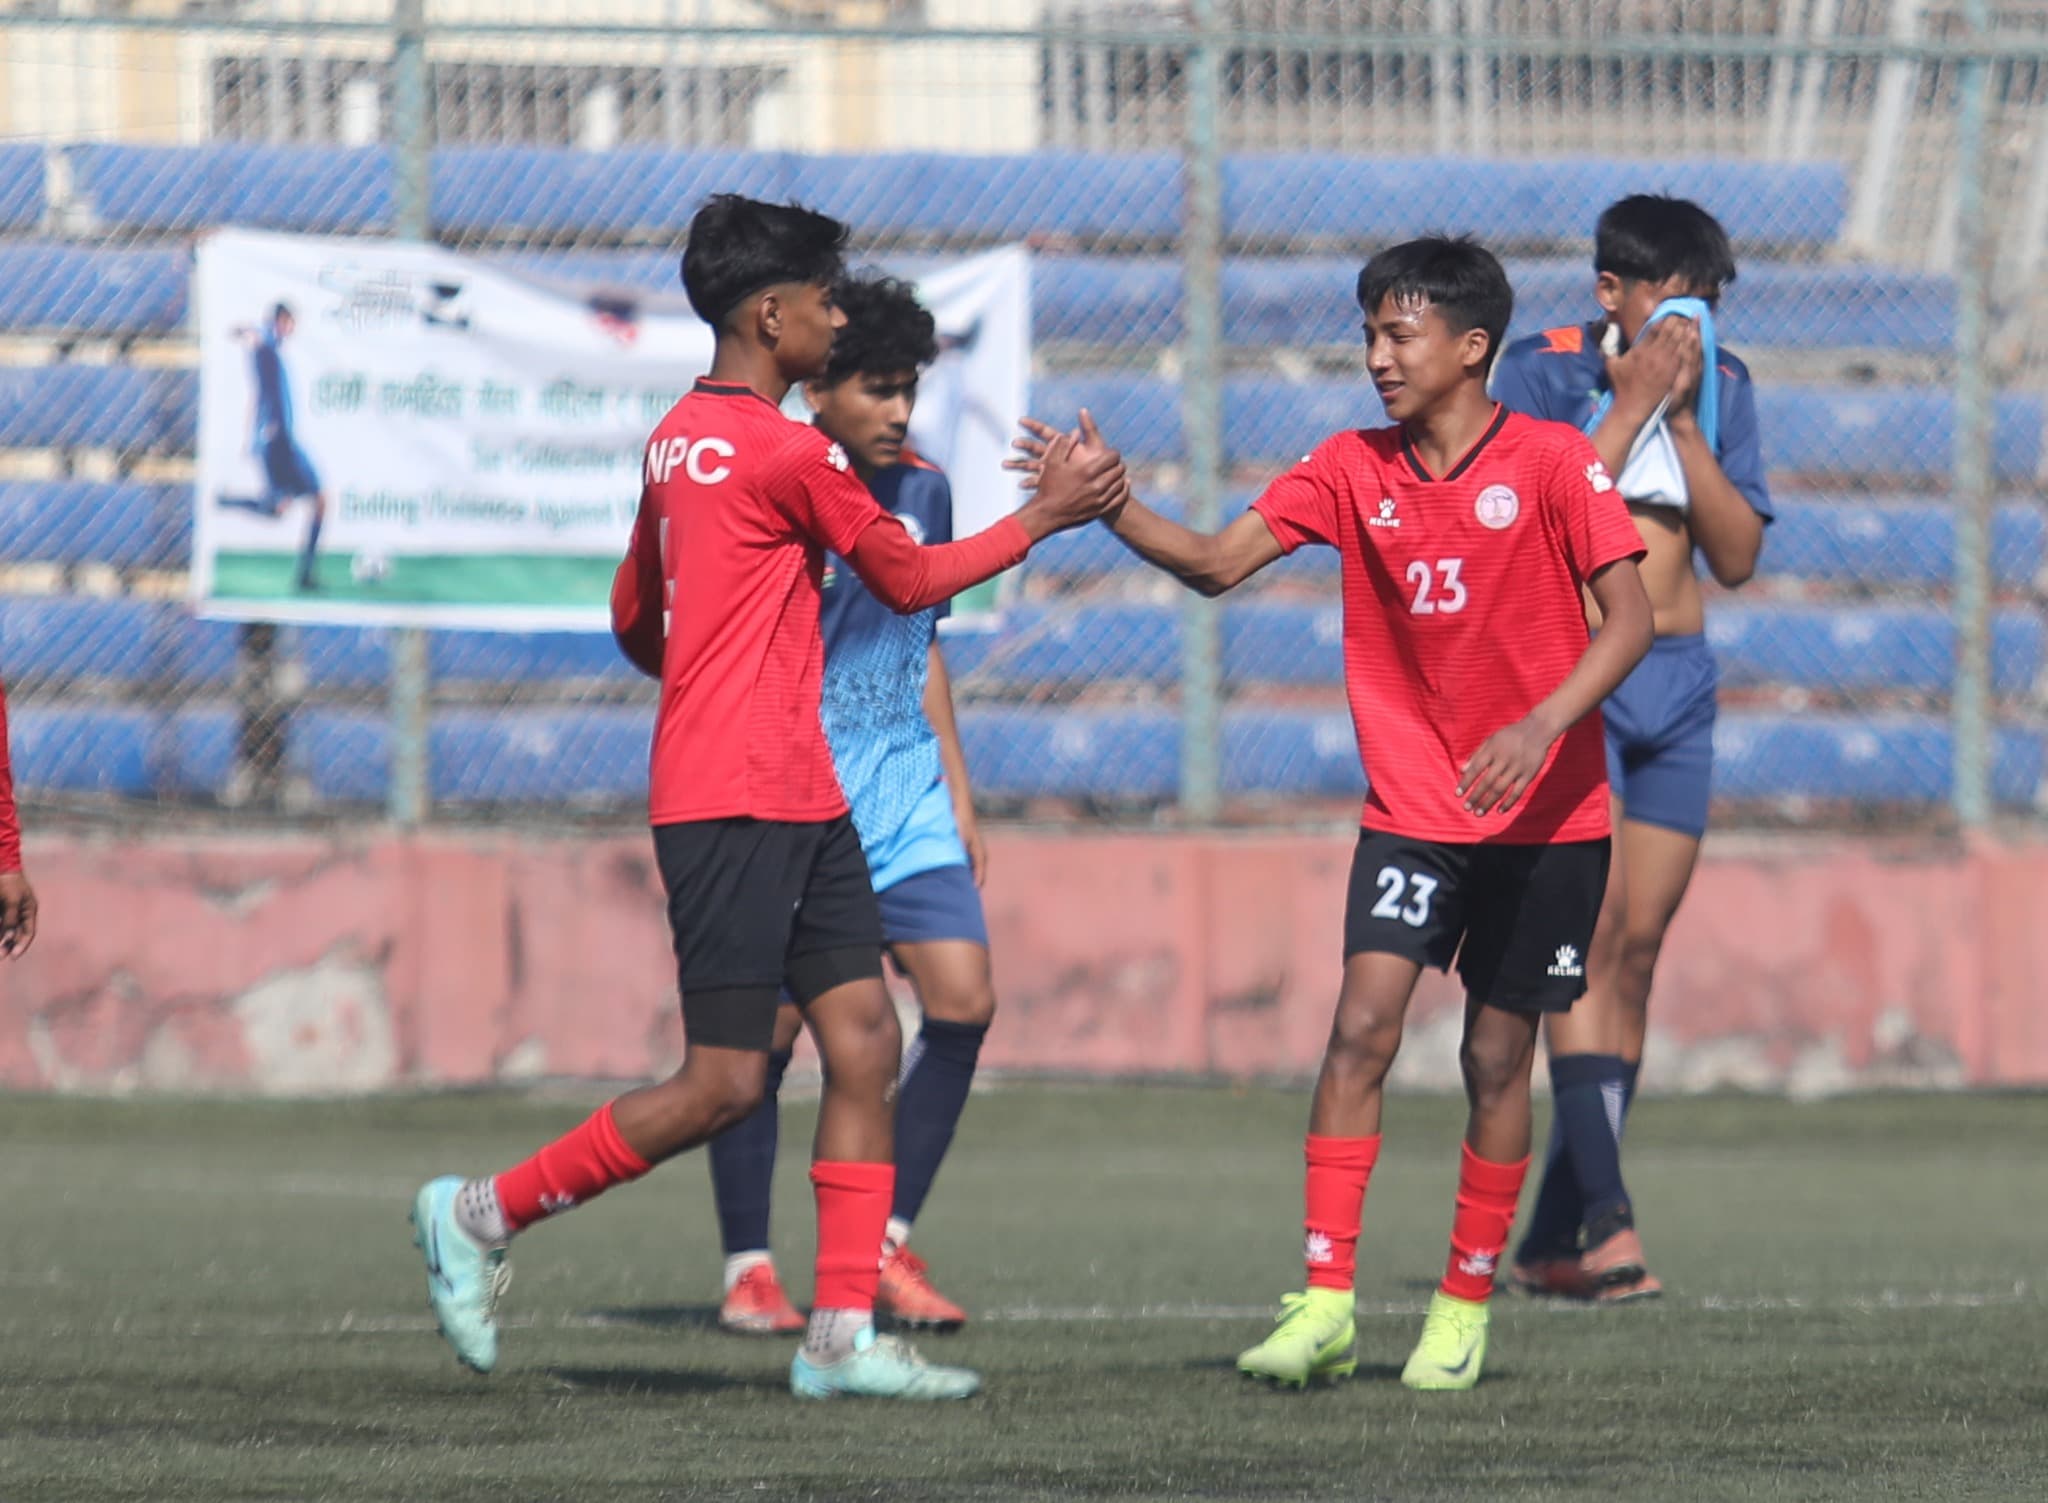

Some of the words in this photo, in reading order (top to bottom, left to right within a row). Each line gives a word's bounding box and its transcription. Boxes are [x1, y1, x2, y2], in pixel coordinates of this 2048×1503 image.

[644, 438, 736, 486] NPC
[1407, 559, 1468, 614] 23
[1371, 867, 1438, 928] 23
